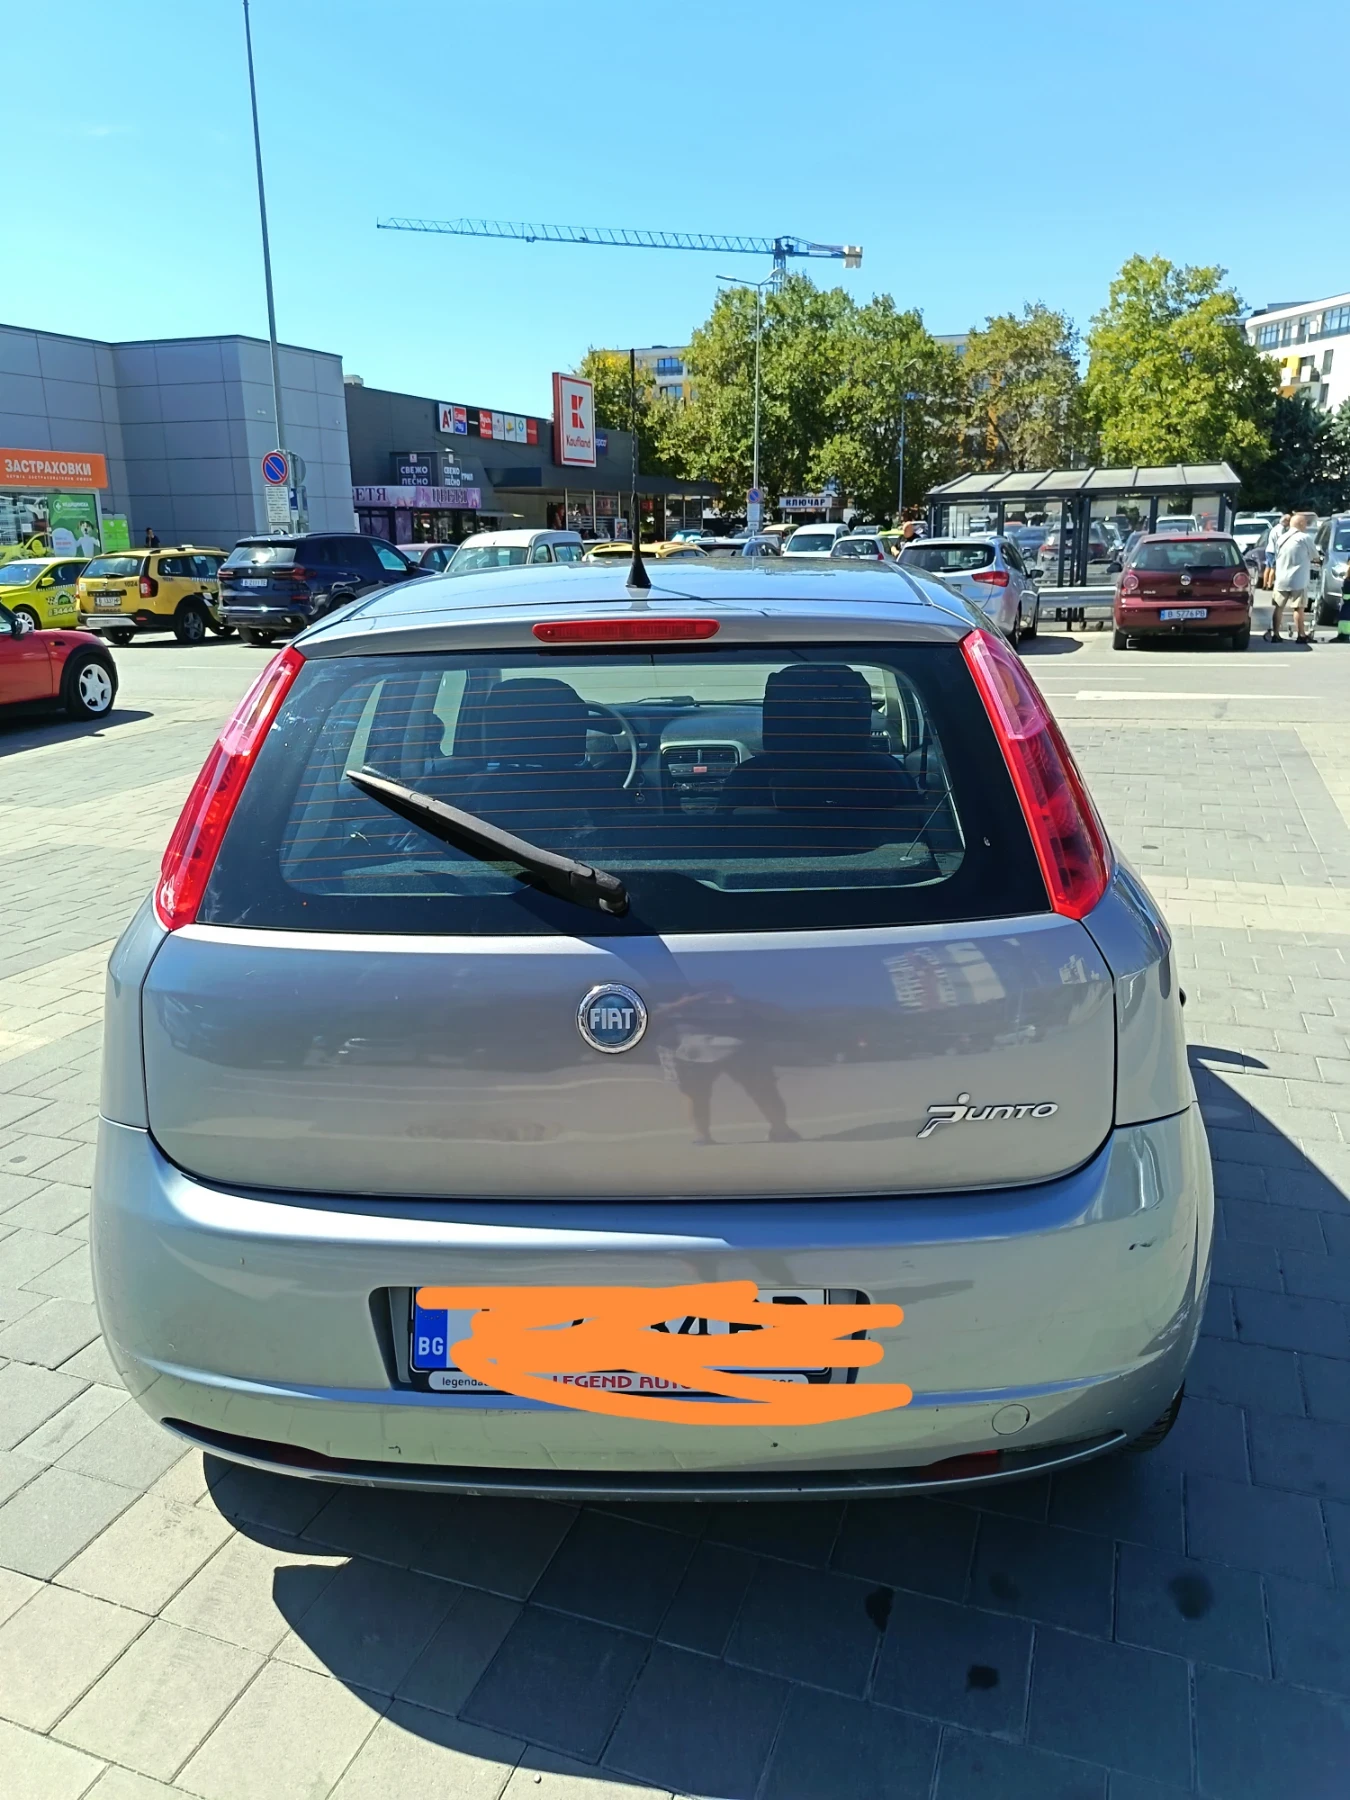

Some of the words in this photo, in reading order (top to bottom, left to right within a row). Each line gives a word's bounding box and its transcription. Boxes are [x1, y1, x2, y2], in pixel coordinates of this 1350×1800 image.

[442, 408, 452, 429] A1
[565, 434, 591, 449] Kaufland
[595, 439, 607, 448] epco
[4, 458, 92, 476] ЗАСТРАХОВКИ
[400, 465, 428, 475] СВЕЖО
[443, 466, 461, 476] СВЕЖО
[352, 487, 387, 502] ЕТЯ
[431, 488, 469, 505] ЦВЕТЯ
[785, 498, 826, 507] КЛЮЧАР
[124, 580, 138, 588] 1024
[589, 1007, 634, 1030] FIAT
[418, 1336, 445, 1357] BG
